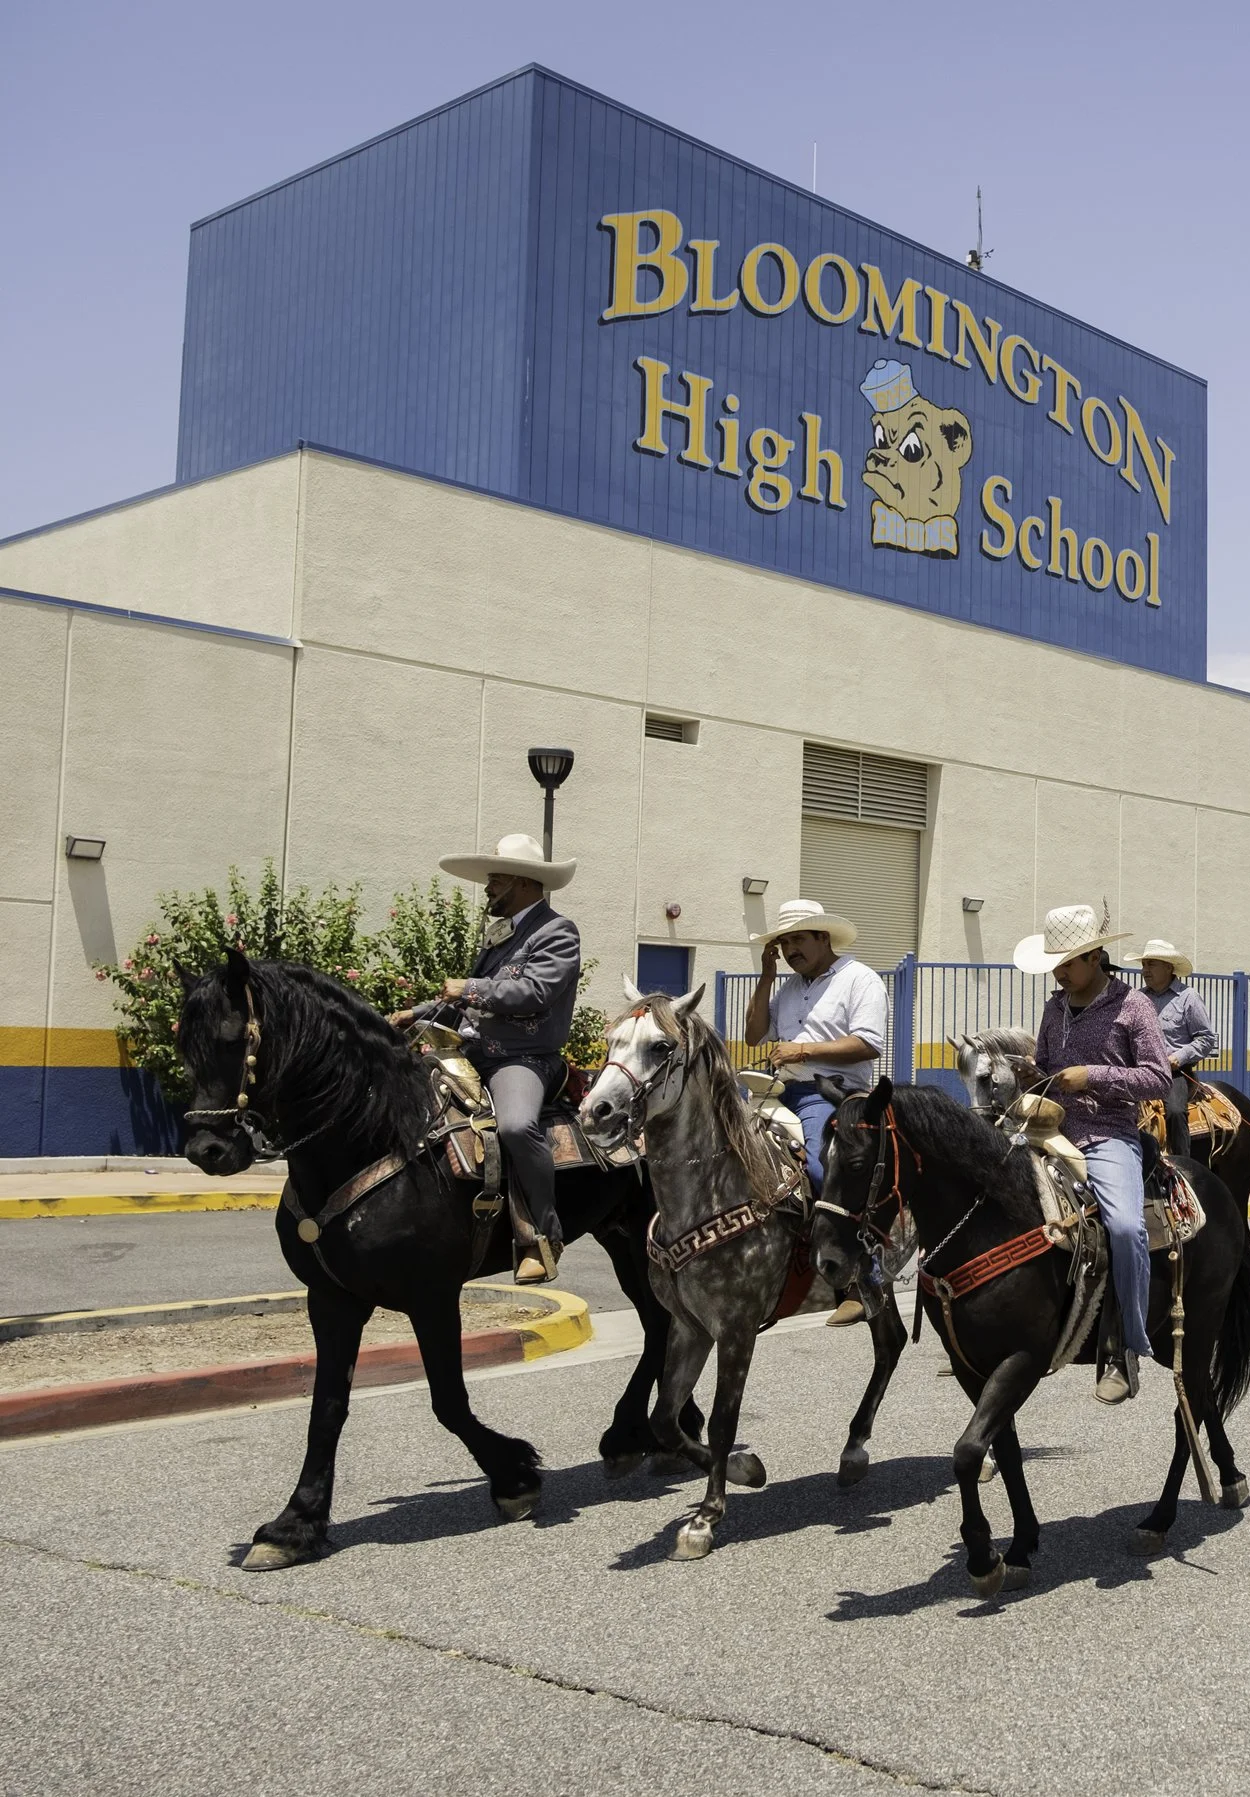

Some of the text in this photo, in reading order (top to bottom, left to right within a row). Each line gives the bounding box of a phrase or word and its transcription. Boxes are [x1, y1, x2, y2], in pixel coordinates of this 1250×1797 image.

[600, 208, 1175, 525] BLOOMINGTON
[636, 355, 1161, 606] High School
[874, 506, 957, 549] BRUINS
